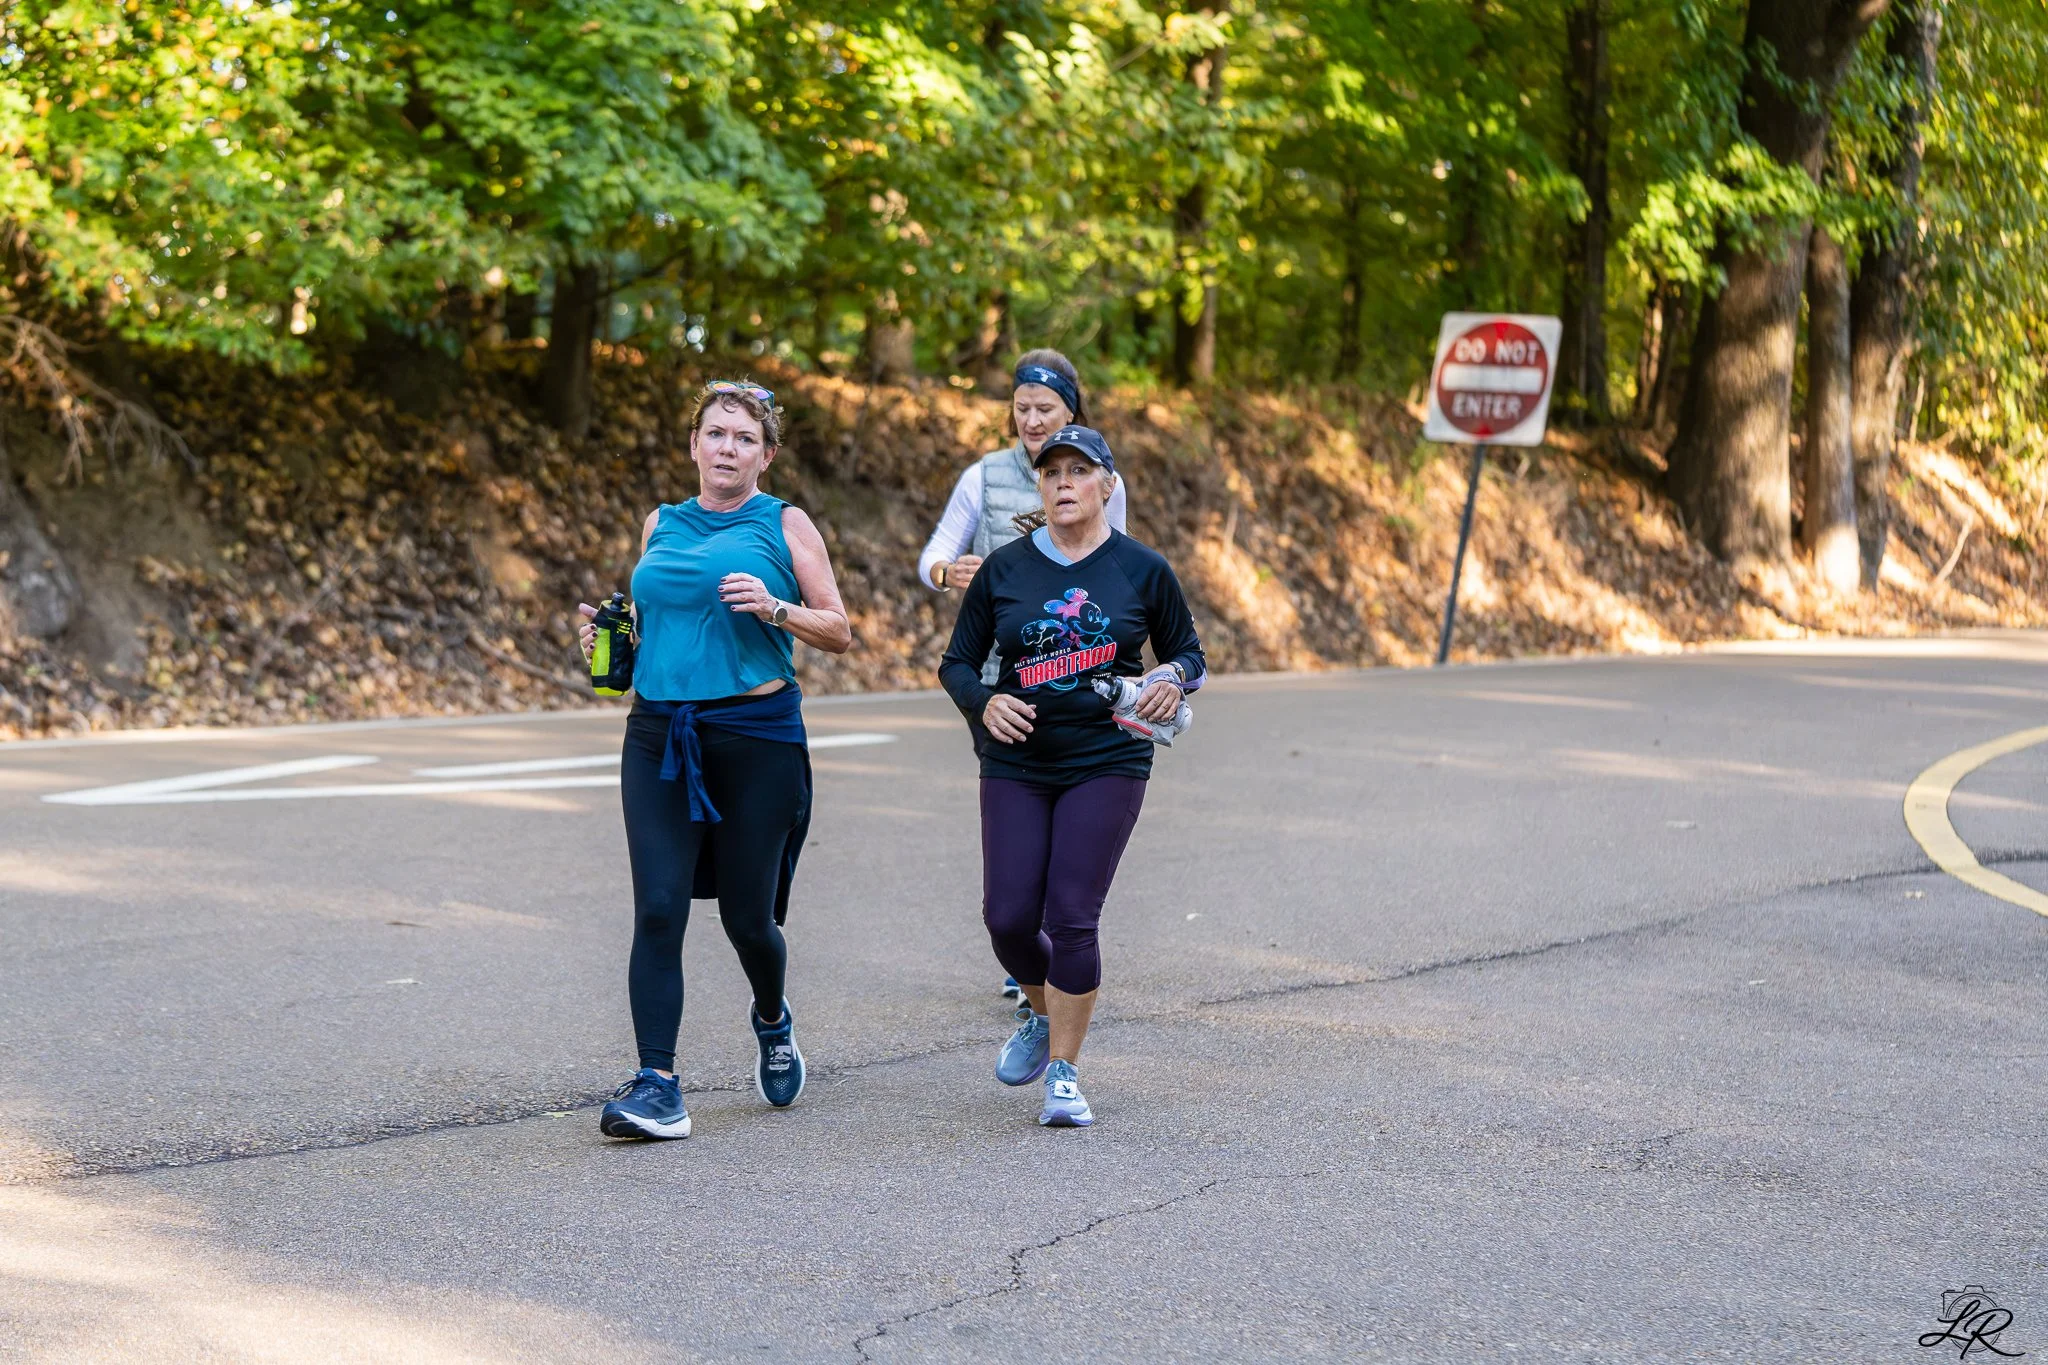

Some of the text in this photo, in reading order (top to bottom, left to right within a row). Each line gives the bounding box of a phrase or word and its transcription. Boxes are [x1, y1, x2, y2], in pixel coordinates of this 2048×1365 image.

[1455, 337, 1540, 365] DO NOT
[1452, 392, 1521, 419] ENTER
[1016, 642, 1117, 689] MARATHON
[1027, 654, 1047, 664] DISNEY
[1050, 647, 1071, 657] WORLD
